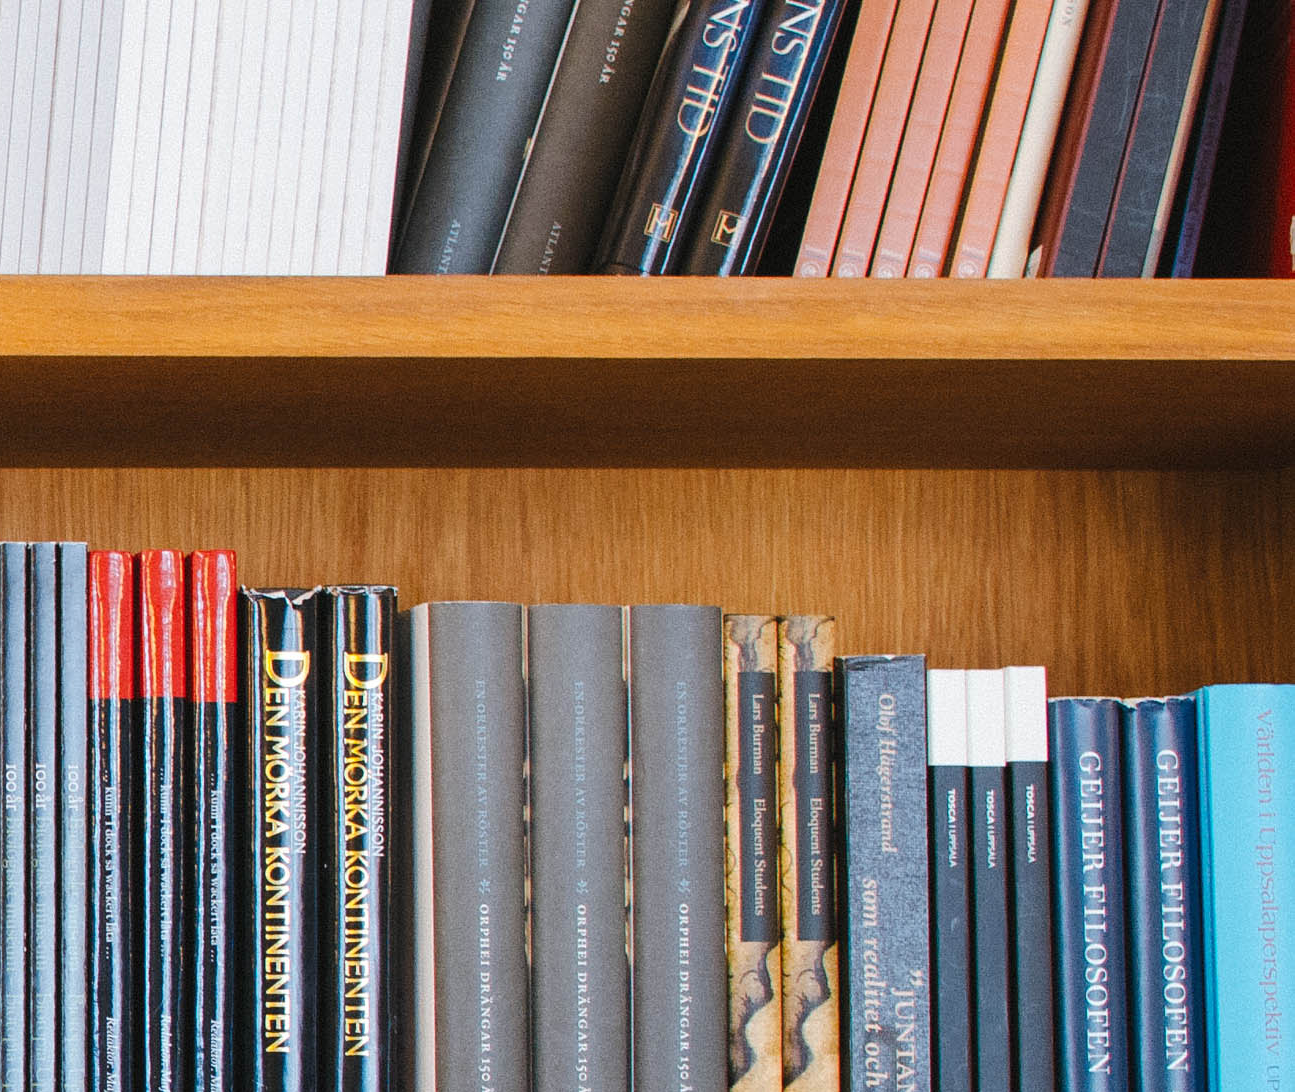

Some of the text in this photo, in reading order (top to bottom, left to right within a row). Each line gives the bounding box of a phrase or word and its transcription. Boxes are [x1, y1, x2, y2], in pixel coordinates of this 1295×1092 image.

[677, 64, 730, 137] TID
[371, 692, 385, 857] KARIN JOHANNISSON
[808, 693, 824, 915] Lars Burman Eloquent Students
[1079, 751, 1105, 872] GEIJER
[343, 651, 388, 1057] DEN MÖRKA KONTINENTEN
[678, 904, 690, 966] ORPHEI
[861, 879, 877, 927] som
[678, 971, 691, 1051] DRÄNGAR
[862, 939, 884, 1031] realitet
[1084, 884, 1110, 1075] FILOSOFEN
[677, 1056, 691, 1081] 150
[864, 1042, 884, 1087] och
